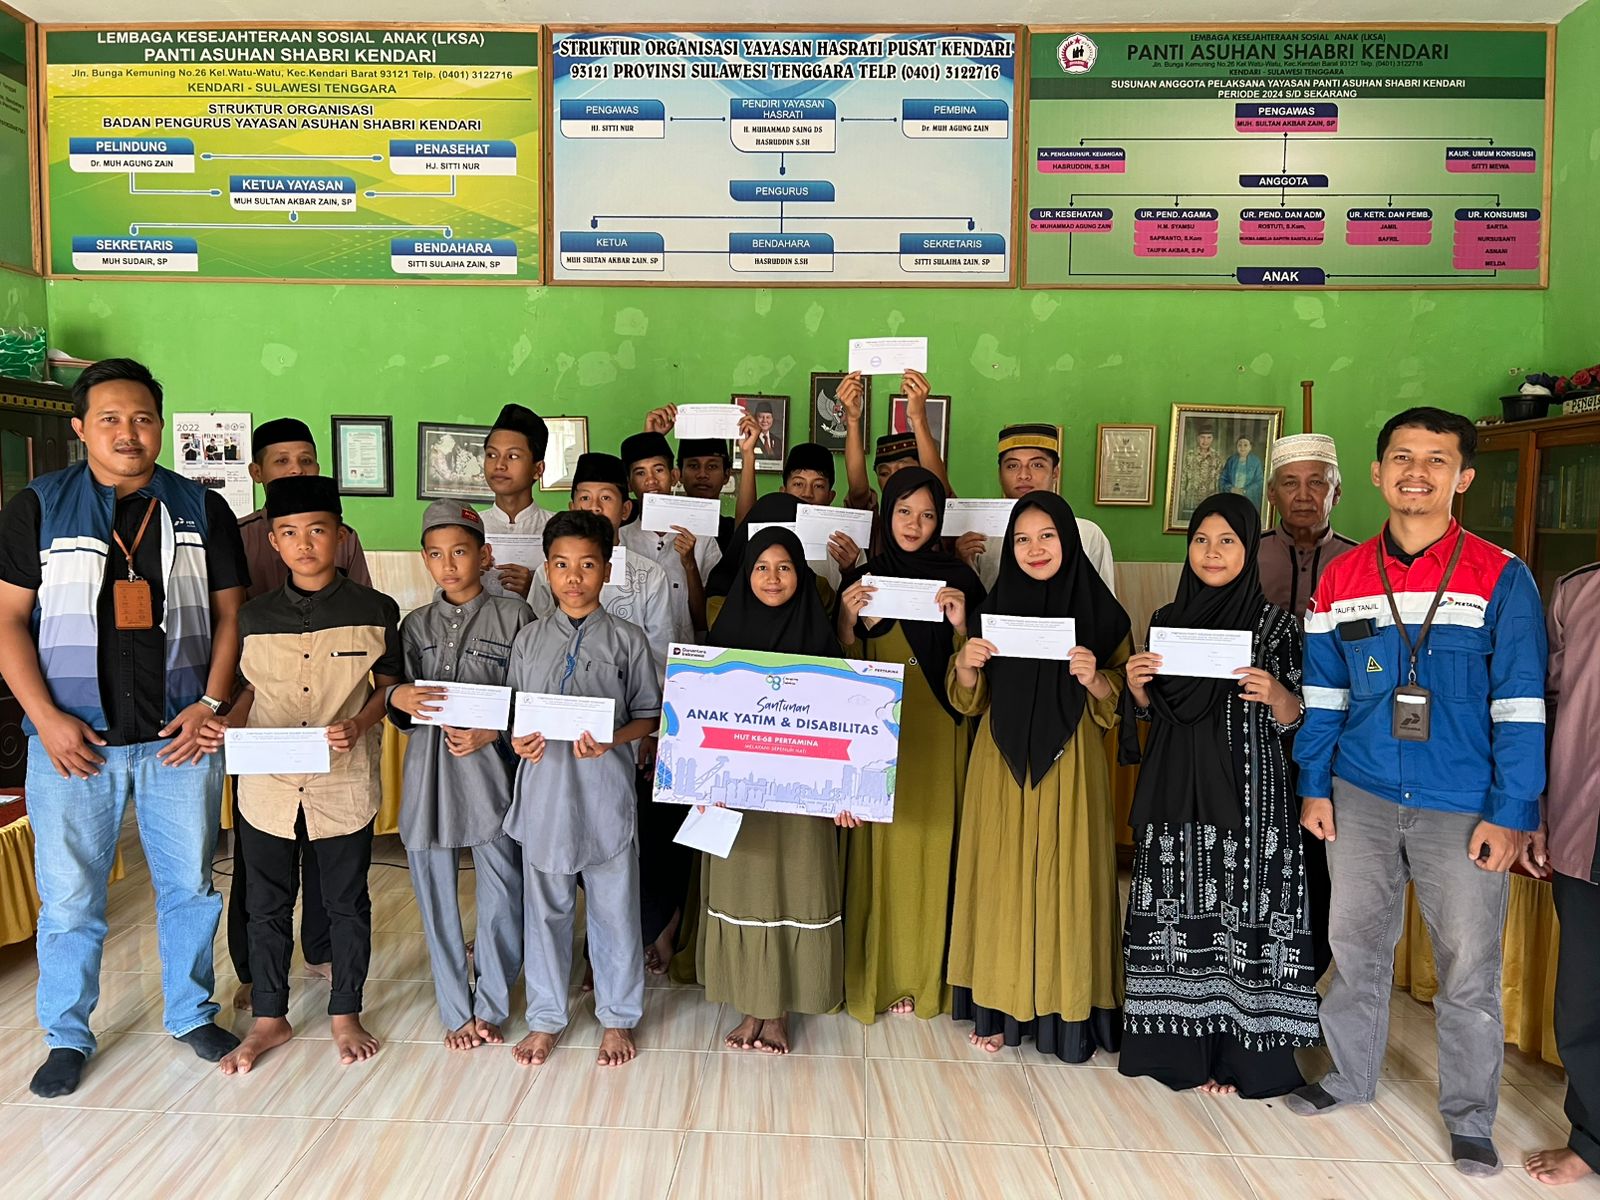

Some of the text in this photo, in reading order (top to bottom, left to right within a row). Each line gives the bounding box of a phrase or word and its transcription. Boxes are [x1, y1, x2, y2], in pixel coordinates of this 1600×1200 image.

[98, 32, 484, 47] LEMBAGA KESEJAHTERAAN SOSIAL ANAK (LKSA)
[560, 41, 1011, 56] STRUKTUR ORGANISASI YAYASAN HASRATI PUSAT KENDARI
[1128, 44, 1449, 60] PANTI ASUHAN SHABRI KENDARI
[144, 49, 436, 63] PANTI ASUHAN SHABRI KENDARI
[72, 69, 512, 80] Jln. Bunga Kemuning No.26 Kel.Watu-Watu, Kec.Kendari Barat 93121 Telp. (0401) 3122716
[572, 64, 999, 80] 93121 PROVINSI SULAWESI TENGGARA TELP. (0401) 3122716
[188, 83, 244, 92] KENDARI
[256, 83, 320, 93] SULAWESI
[324, 84, 396, 93] TENGGARA
[209, 104, 373, 115] STRUKTUR ORGANISASI
[586, 106, 639, 114] PENGAWAS
[934, 106, 976, 114] PEMBINA
[1258, 107, 1315, 115] PENGAWAS
[103, 118, 481, 130] BADAN PENGURUS YAYASAN ASUHAN SHABRI KENDARI
[96, 142, 167, 152] PELINDUNG
[416, 144, 489, 154] PENASEHAT
[242, 180, 343, 191] KETUA YAYASAN
[1259, 177, 1308, 185] ANGGOTA
[756, 187, 808, 195] PENGURUS
[96, 240, 173, 250] SEKRETARIS
[415, 243, 492, 253] BENDAHARA
[122, 258, 155, 266] SUDAIR,
[467, 261, 487, 269] ZAIN,
[1262, 271, 1299, 281] ANAK
[756, 696, 810, 714] Santunan
[686, 708, 879, 735] ANAK YATIM & DISABILITAS
[751, 735, 772, 743] KE-68
[774, 736, 818, 747] PERTAMINA
